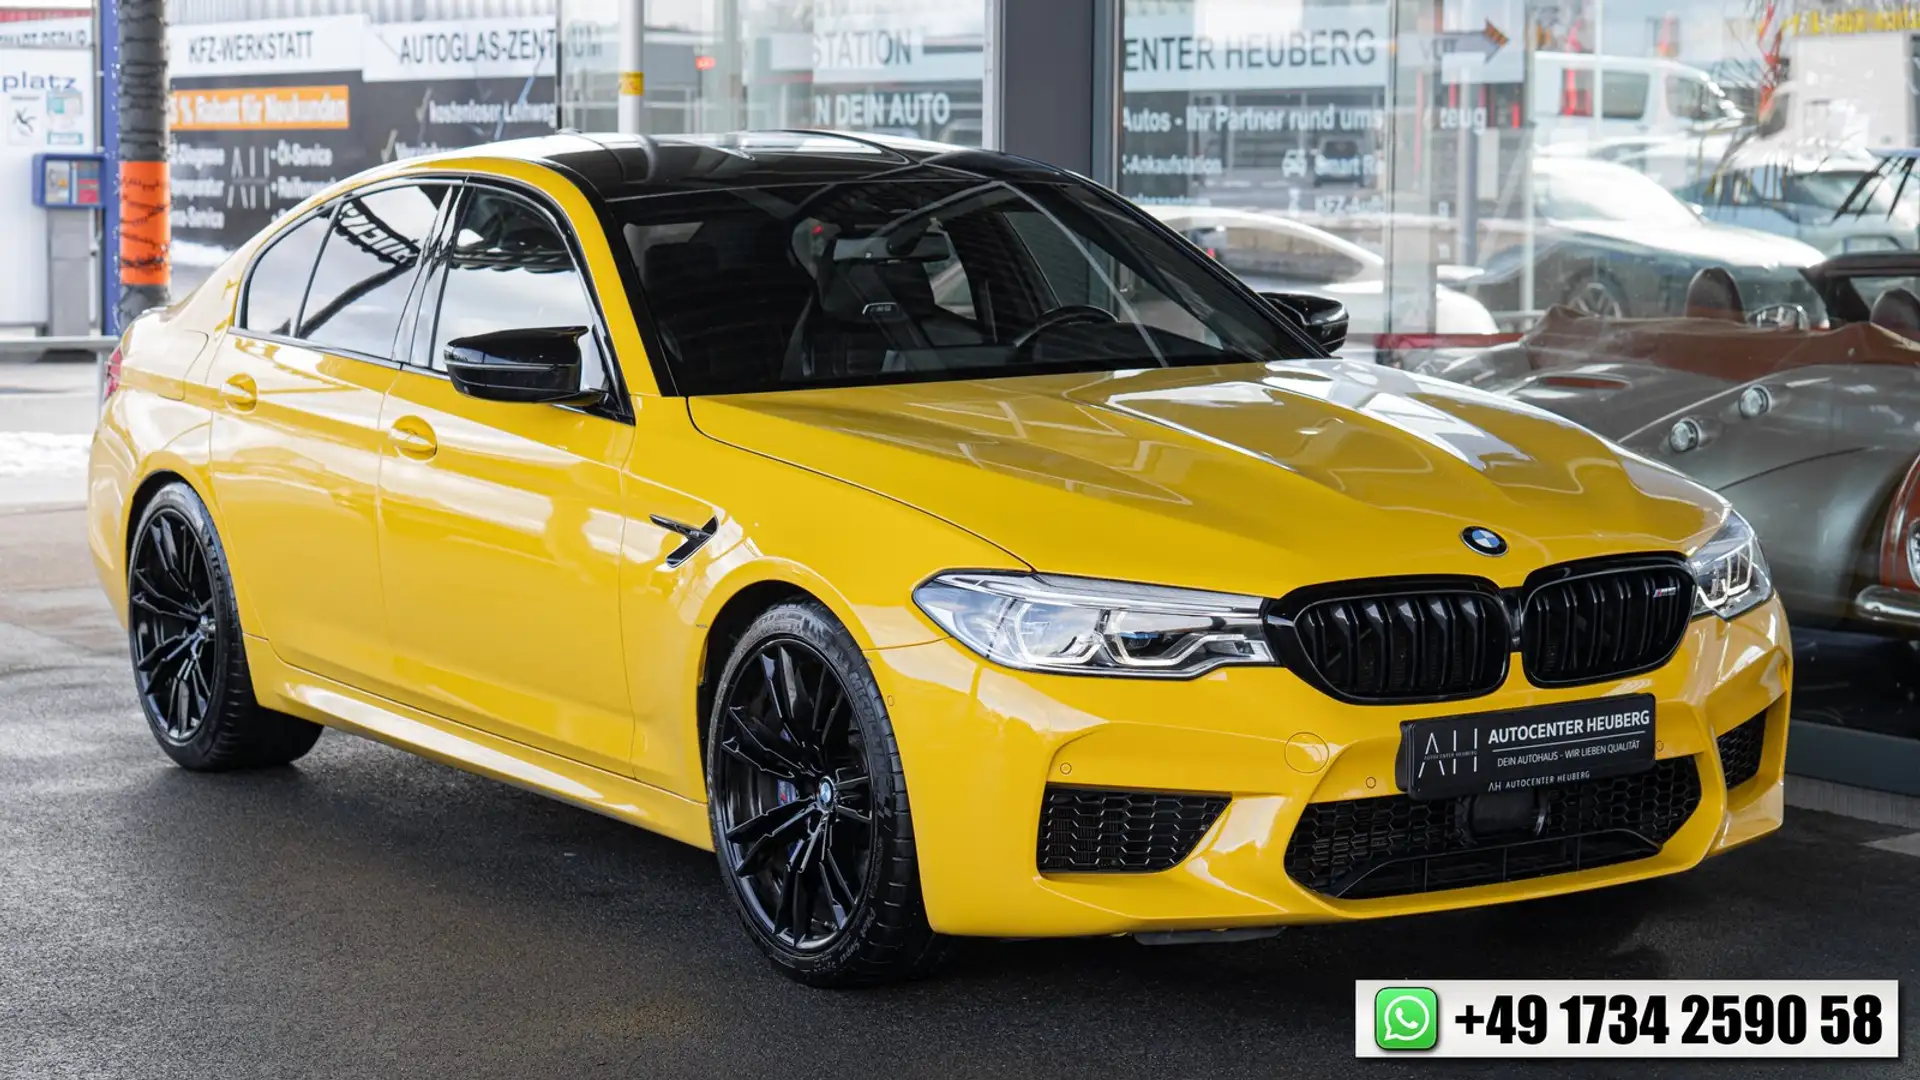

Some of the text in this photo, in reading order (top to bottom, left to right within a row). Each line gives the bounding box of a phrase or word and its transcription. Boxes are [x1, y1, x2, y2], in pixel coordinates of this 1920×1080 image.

[188, 30, 314, 63] KFZ-WERKSTATT
[1225, 28, 1377, 69] HEUBERG
[836, 92, 885, 125] DEIN
[889, 92, 951, 125] AUTO
[1186, 107, 1210, 132] Ihr
[1216, 105, 1285, 132] Partner
[1290, 103, 1335, 131] rund
[1488, 709, 1651, 745] AUTOCENTER HEUBERG
[1418, 727, 1479, 780] AH
[1497, 755, 1517, 768] DEIN
[1517, 751, 1559, 766] AUTOHAUS
[1564, 748, 1580, 760] WIR
[1581, 745, 1607, 758] LIEBEN
[1607, 739, 1641, 754] QUALITÄT
[1505, 775, 1555, 790] AUTOCENTER
[1557, 770, 1591, 783] HEUBERG
